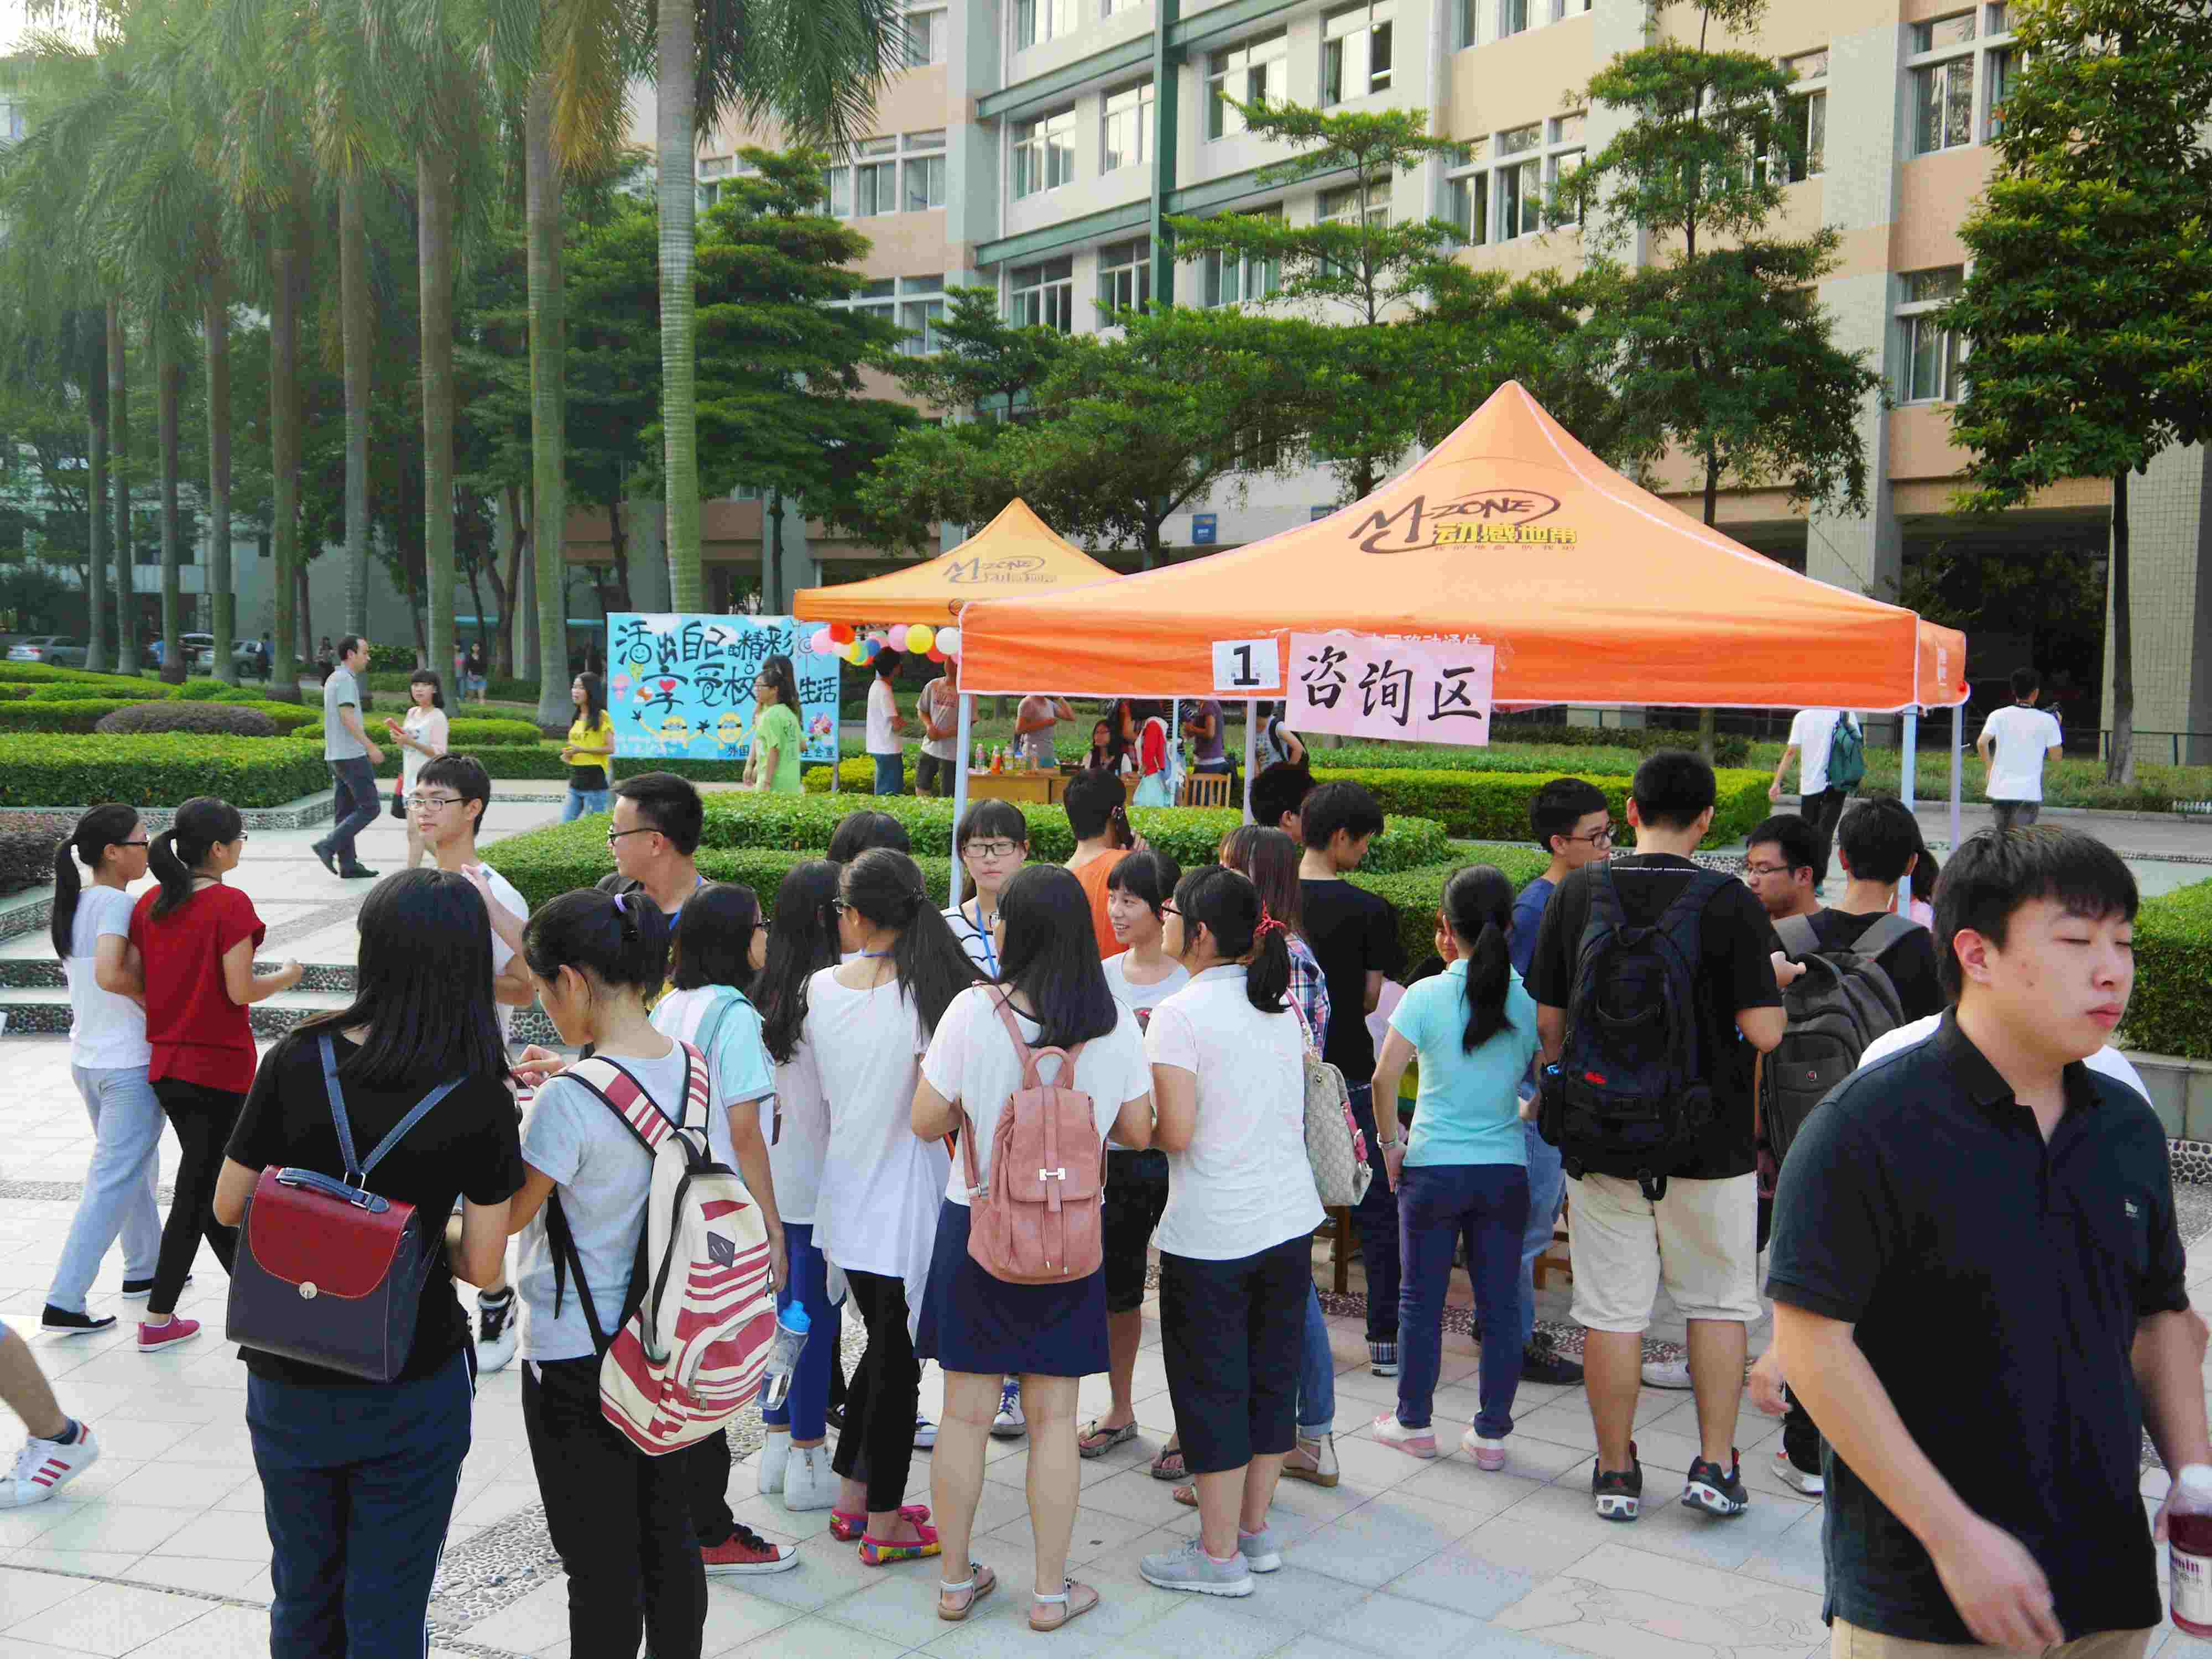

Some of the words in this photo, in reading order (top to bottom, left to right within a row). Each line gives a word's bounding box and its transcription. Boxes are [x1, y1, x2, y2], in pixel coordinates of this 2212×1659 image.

[615, 620, 794, 665] 活出自己的精彩
[1233, 644, 1260, 685] 1
[1301, 645, 1482, 726] 咨询区
